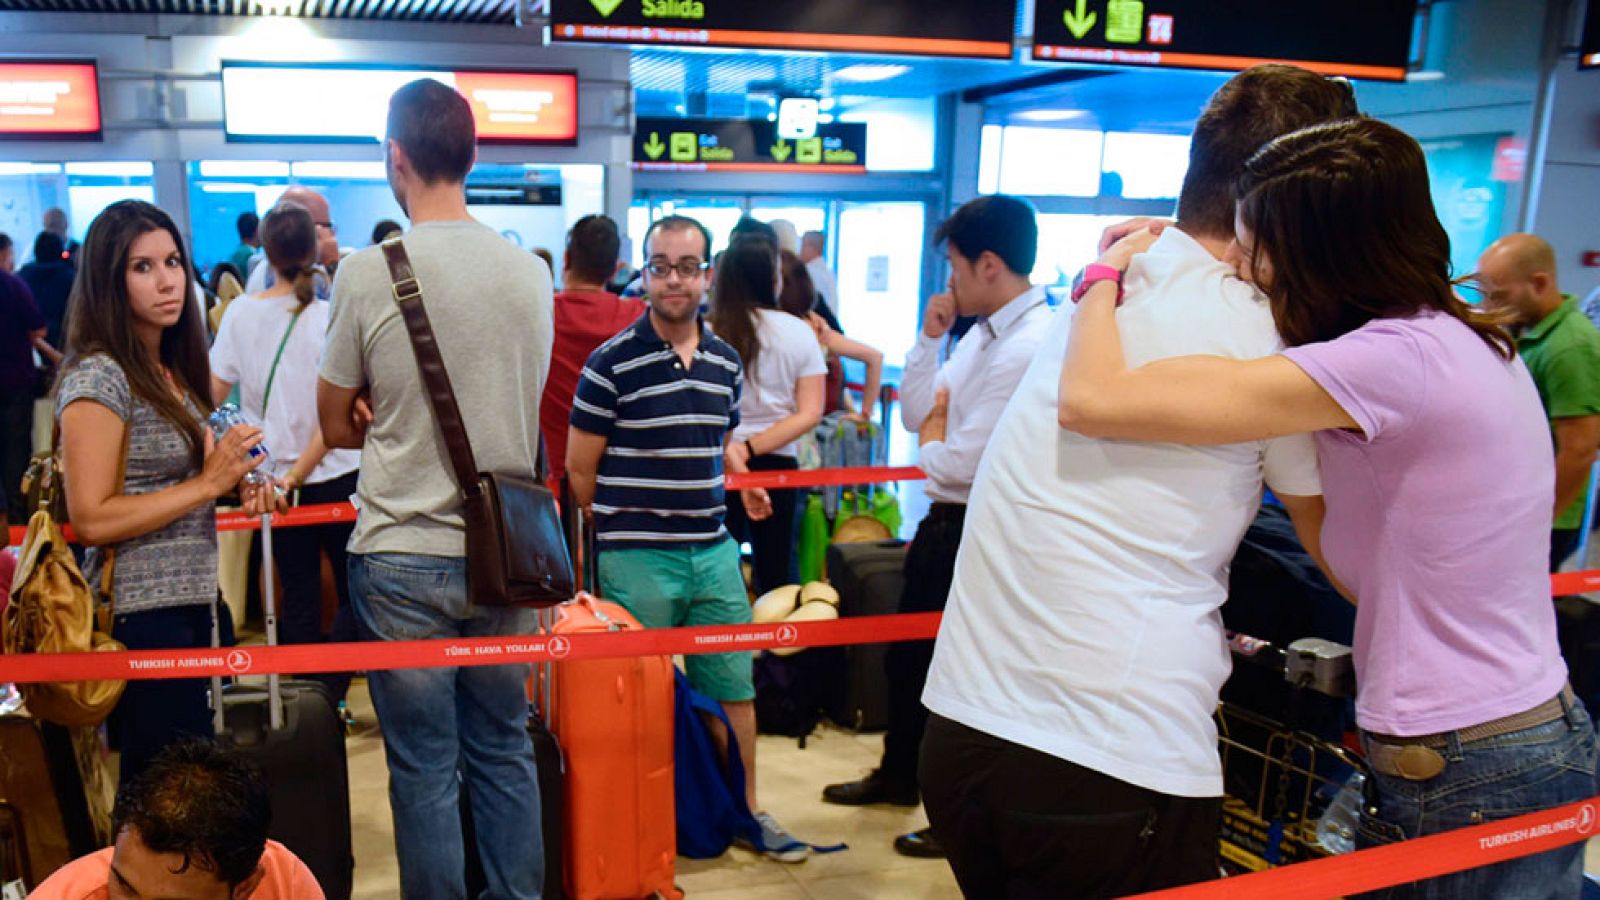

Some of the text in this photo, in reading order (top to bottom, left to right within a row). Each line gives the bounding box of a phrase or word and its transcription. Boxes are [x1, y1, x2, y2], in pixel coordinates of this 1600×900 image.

[642, 0, 704, 18] Salida
[694, 632, 774, 644] TURKISH AIRLINES
[475, 645, 502, 654] HAVA
[128, 657, 224, 669] TURKISH AIRLINES
[1479, 818, 1578, 849] TURKISH AIRLINES
